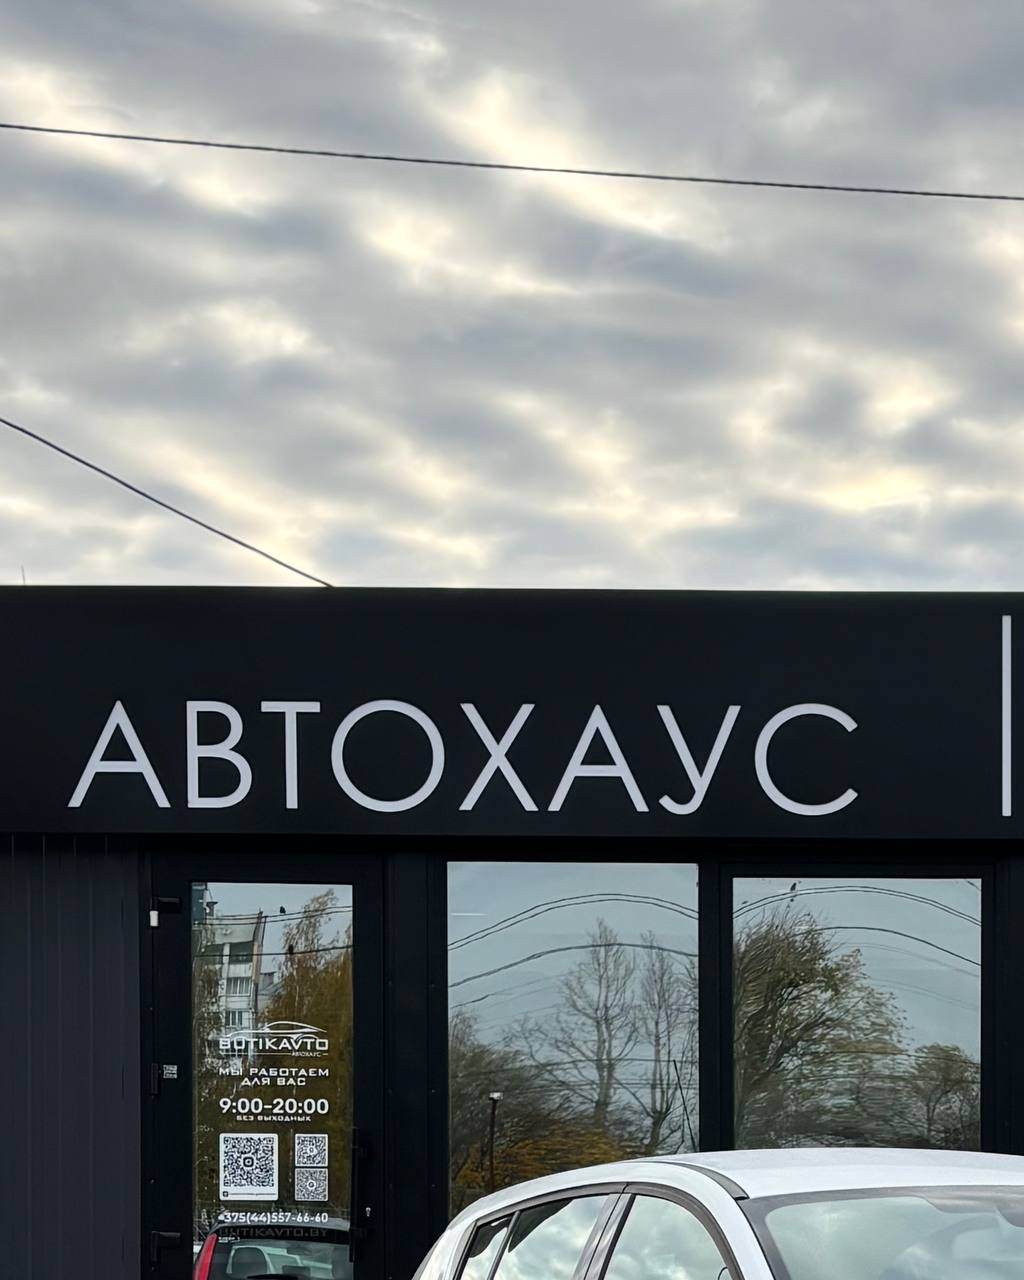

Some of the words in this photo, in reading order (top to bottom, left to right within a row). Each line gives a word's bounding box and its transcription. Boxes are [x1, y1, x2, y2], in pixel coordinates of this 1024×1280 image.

[67, 699, 859, 817] АВТОХАУС
[219, 1038, 329, 1051] BUTIKAVTO
[219, 1068, 243, 1076] МЫ
[250, 1068, 329, 1076] РАБОТАЕМ
[241, 1078, 270, 1086] ДЛЯ
[277, 1078, 306, 1086] ВАС
[219, 1097, 329, 1114] 9:00-20:00
